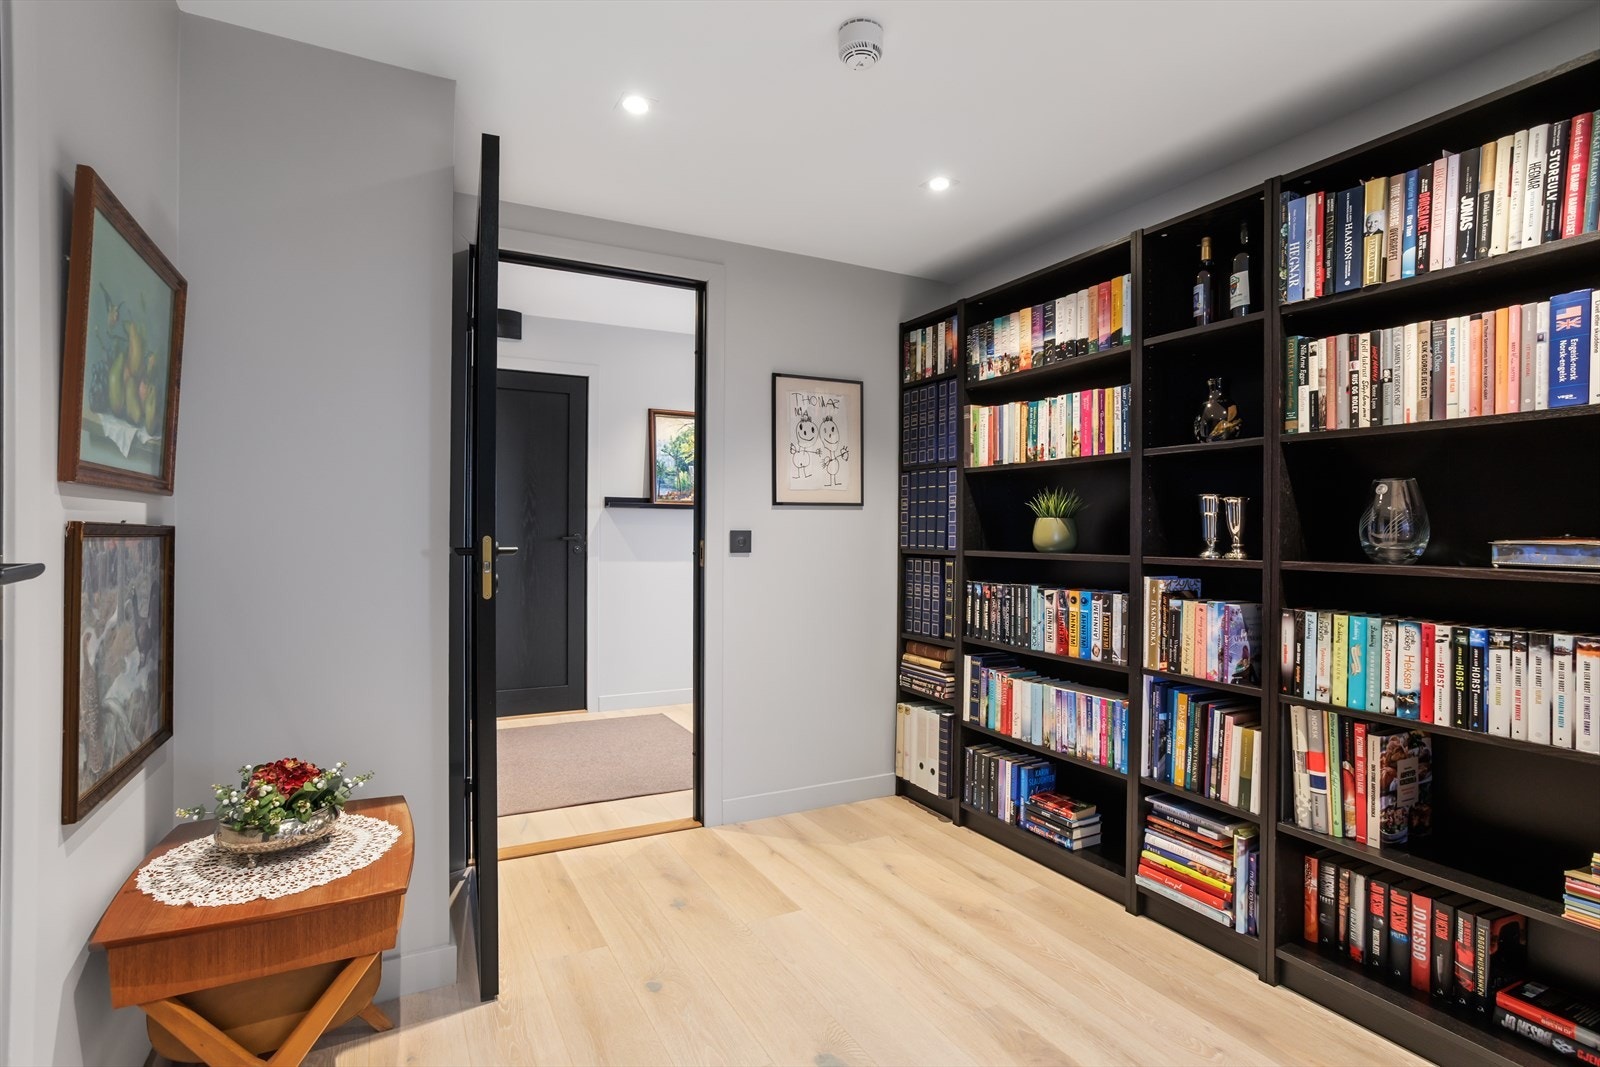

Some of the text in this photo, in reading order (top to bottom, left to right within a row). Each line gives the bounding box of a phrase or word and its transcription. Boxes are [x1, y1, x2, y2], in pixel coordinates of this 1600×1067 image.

[1575, 118, 1584, 136] Knut
[1528, 161, 1542, 191] HEGNAR
[1547, 149, 1561, 201] STOREULV
[1572, 163, 1580, 174] EN
[1460, 195, 1474, 231] JONAS
[1325, 215, 1335, 246] DIANA
[1344, 222, 1353, 260] HAAKON
[1289, 241, 1301, 288] HEGNAR
[1361, 338, 1369, 353] Kjell
[1568, 338, 1578, 381] Engelsk-norsk
[1434, 354, 1442, 372] Olsen
[1557, 340, 1568, 383] Norsk-engelsk
[1352, 386, 1358, 395] OG
[1403, 654, 1415, 689] Heksen
[1437, 662, 1445, 689] HORST
[1455, 664, 1464, 691] HORST
[1472, 666, 1480, 693] HORST
[1311, 715, 1319, 739] NORSK
[1370, 882, 1384, 892] JO
[1370, 892, 1384, 918] NESBØ
[1390, 890, 1408, 935] JO NESBØ
[1413, 904, 1427, 961] JO NESBØ
[1435, 909, 1448, 940] JO NESBØ
[1464, 920, 1471, 928] JO
[1477, 928, 1485, 997] FLAGGERMUSMANNEN
[1501, 1013, 1553, 1047] JO NESBØ
